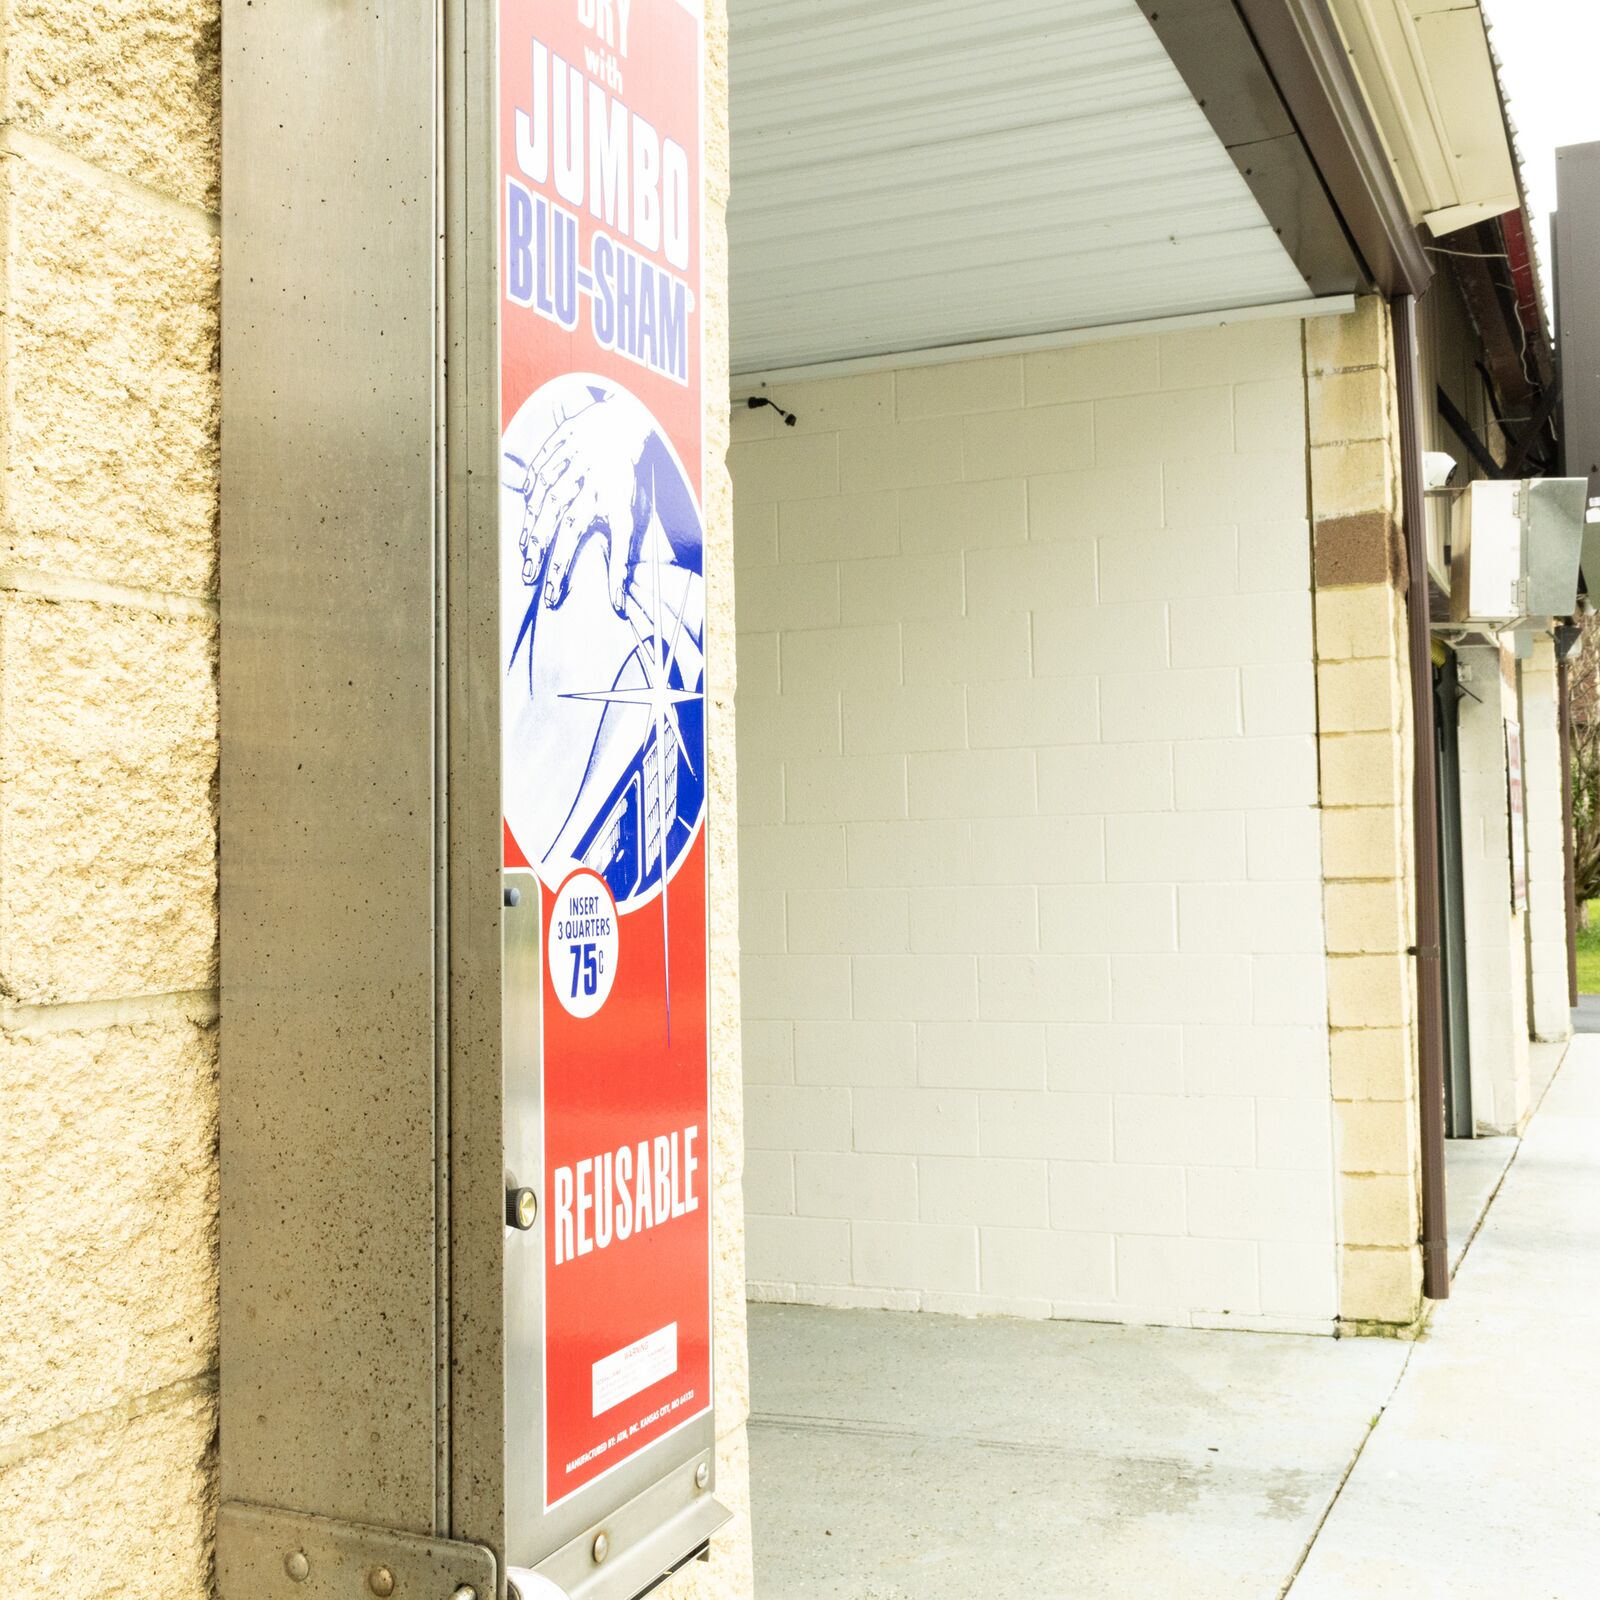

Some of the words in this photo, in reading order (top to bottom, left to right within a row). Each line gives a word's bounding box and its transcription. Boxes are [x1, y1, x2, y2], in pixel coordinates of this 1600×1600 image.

[583, 44, 623, 96] with
[514, 36, 689, 272] JUMBO
[557, 921, 564, 940] 3
[565, 917, 610, 939] QUARTERS
[569, 896, 599, 916] INSERT
[554, 1125, 698, 1265] REUSABLE
[565, 1441, 607, 1474] MANUFACTURED
[640, 1409, 660, 1428] KANSAS
[660, 1403, 671, 1417] CITY,
[671, 1398, 680, 1410] MO
